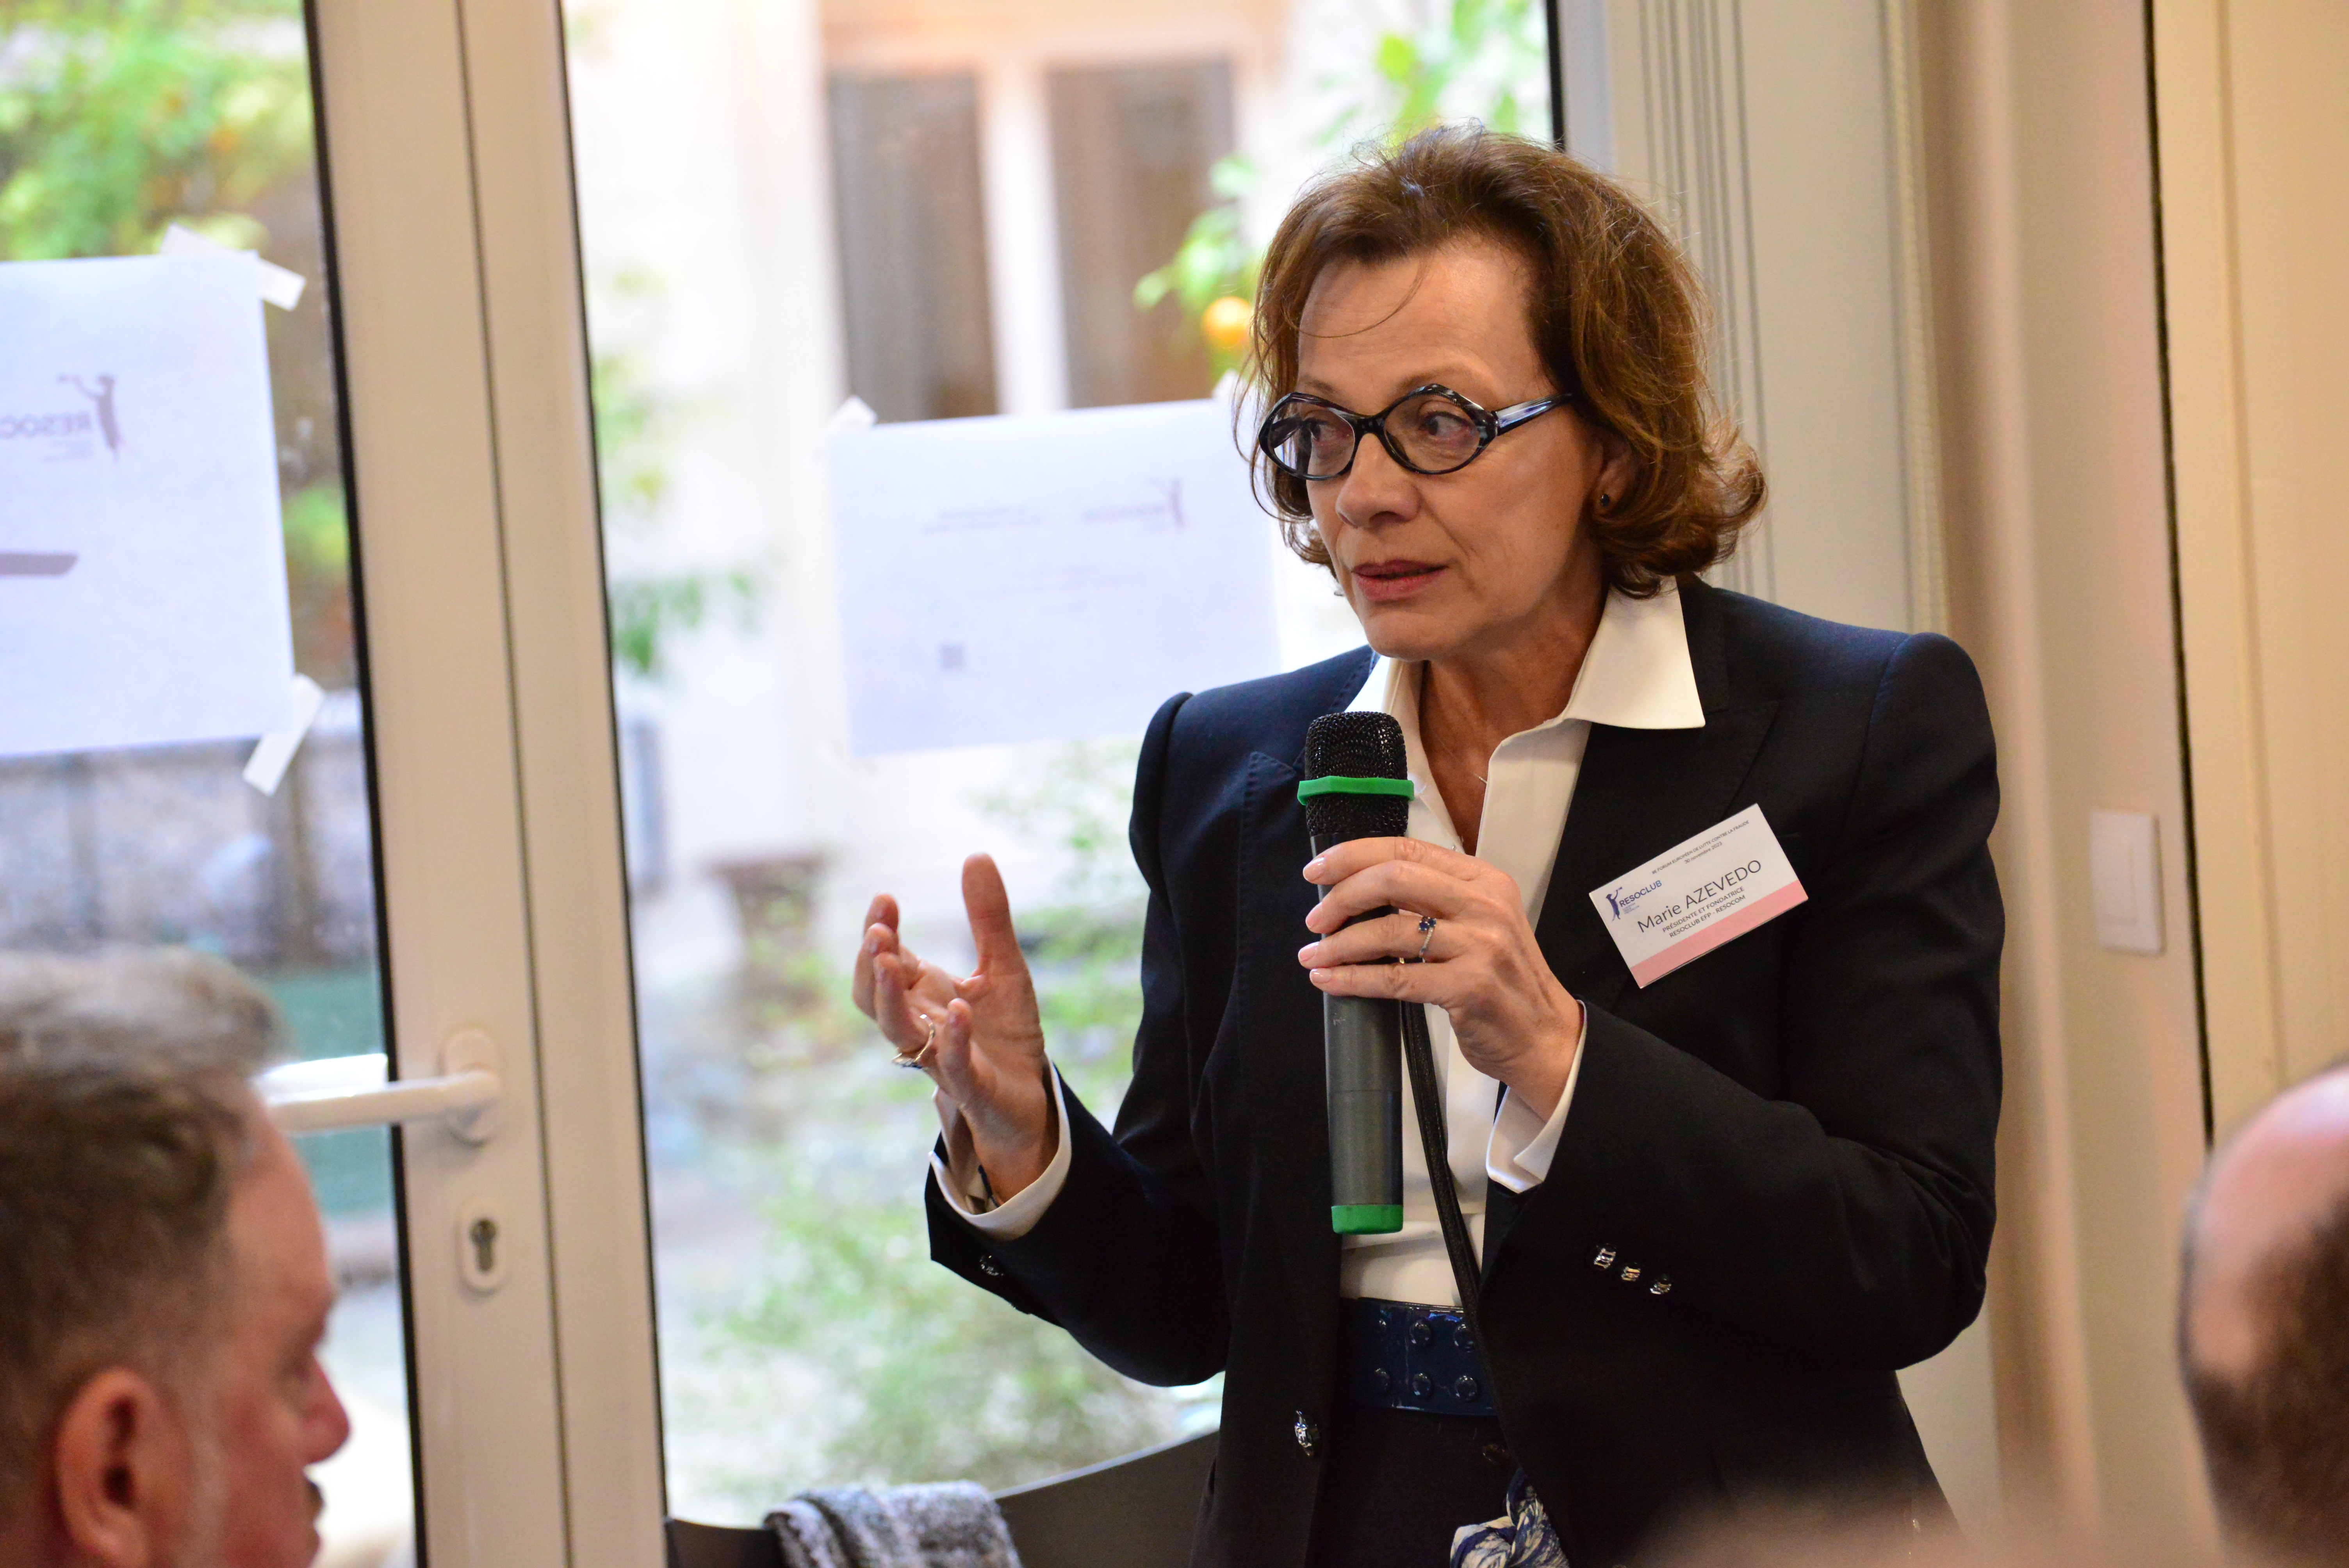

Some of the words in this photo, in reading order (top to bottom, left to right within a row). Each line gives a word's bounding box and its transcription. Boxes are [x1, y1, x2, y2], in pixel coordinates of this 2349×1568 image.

[1657, 861, 1672, 871] FORUM
[1672, 850, 1693, 864] EUROPÉEN
[1698, 840, 1711, 849] LUTTE
[1711, 832, 1727, 842] CONTRE
[1733, 820, 1749, 831] FRAUDE
[1690, 848, 1711, 861] novembre
[1711, 841, 1722, 850] 2023
[1619, 880, 1662, 907] RESOCLUB
[1637, 905, 1682, 933] Marie
[1686, 860, 1761, 909] AZEVEDO
[1662, 911, 1698, 933] PRÉSIDENTE
[1706, 886, 1744, 909] FONDATRICE
[1669, 919, 1700, 938] RESOCLUB
[1700, 912, 1711, 921] EFP
[1715, 895, 1746, 913] RESOCOM
